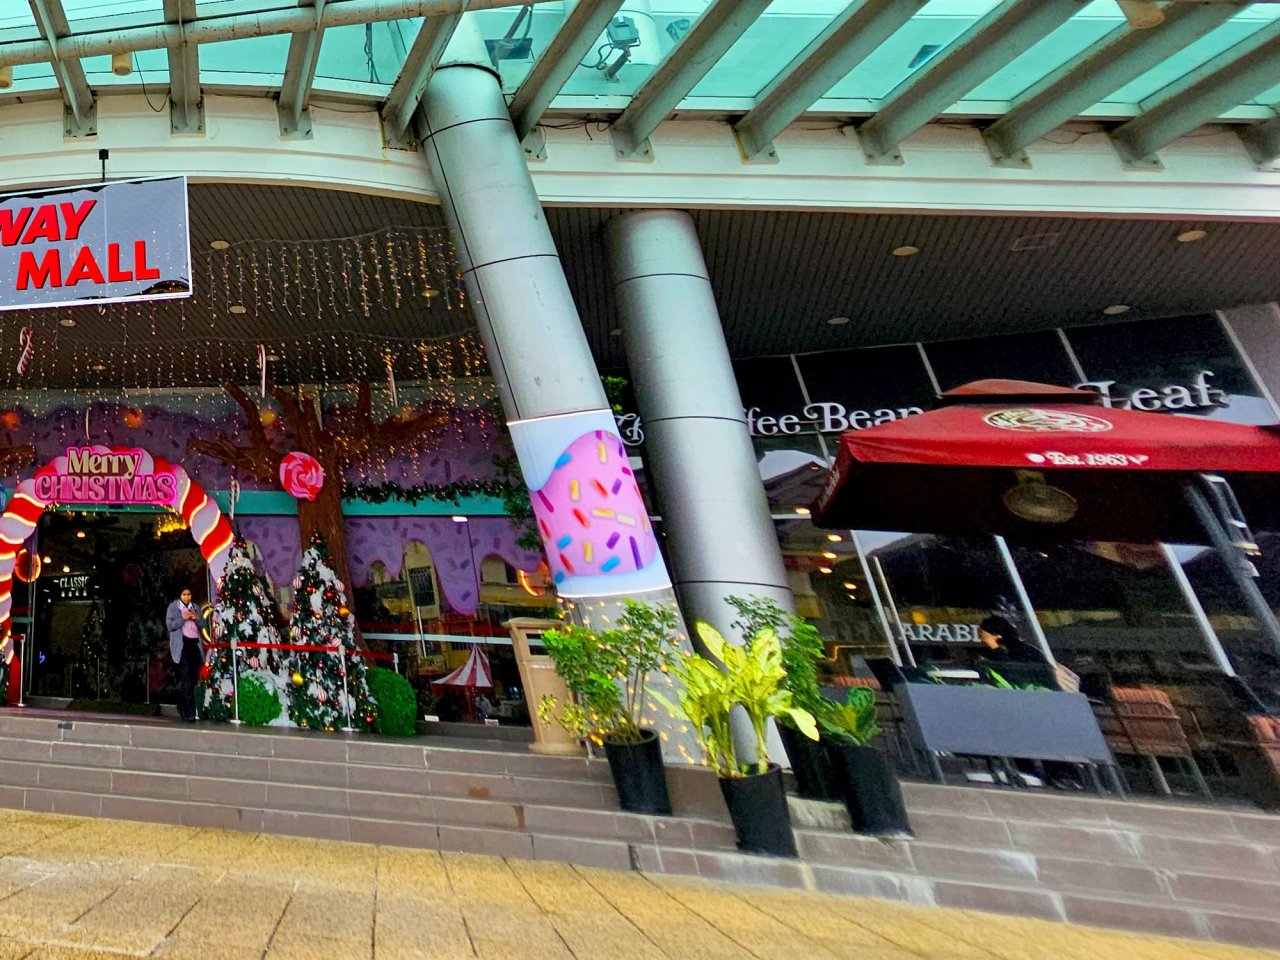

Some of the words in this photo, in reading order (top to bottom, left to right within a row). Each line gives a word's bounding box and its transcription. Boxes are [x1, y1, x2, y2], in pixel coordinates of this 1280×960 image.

[16, 240, 160, 290] MALL
[1074, 370, 1217, 410] Leaf
[68, 449, 140, 480] Merry
[1045, 451, 1085, 465] Est.
[1084, 453, 1129, 466] 1963
[35, 475, 175, 502] CHRISTMAS
